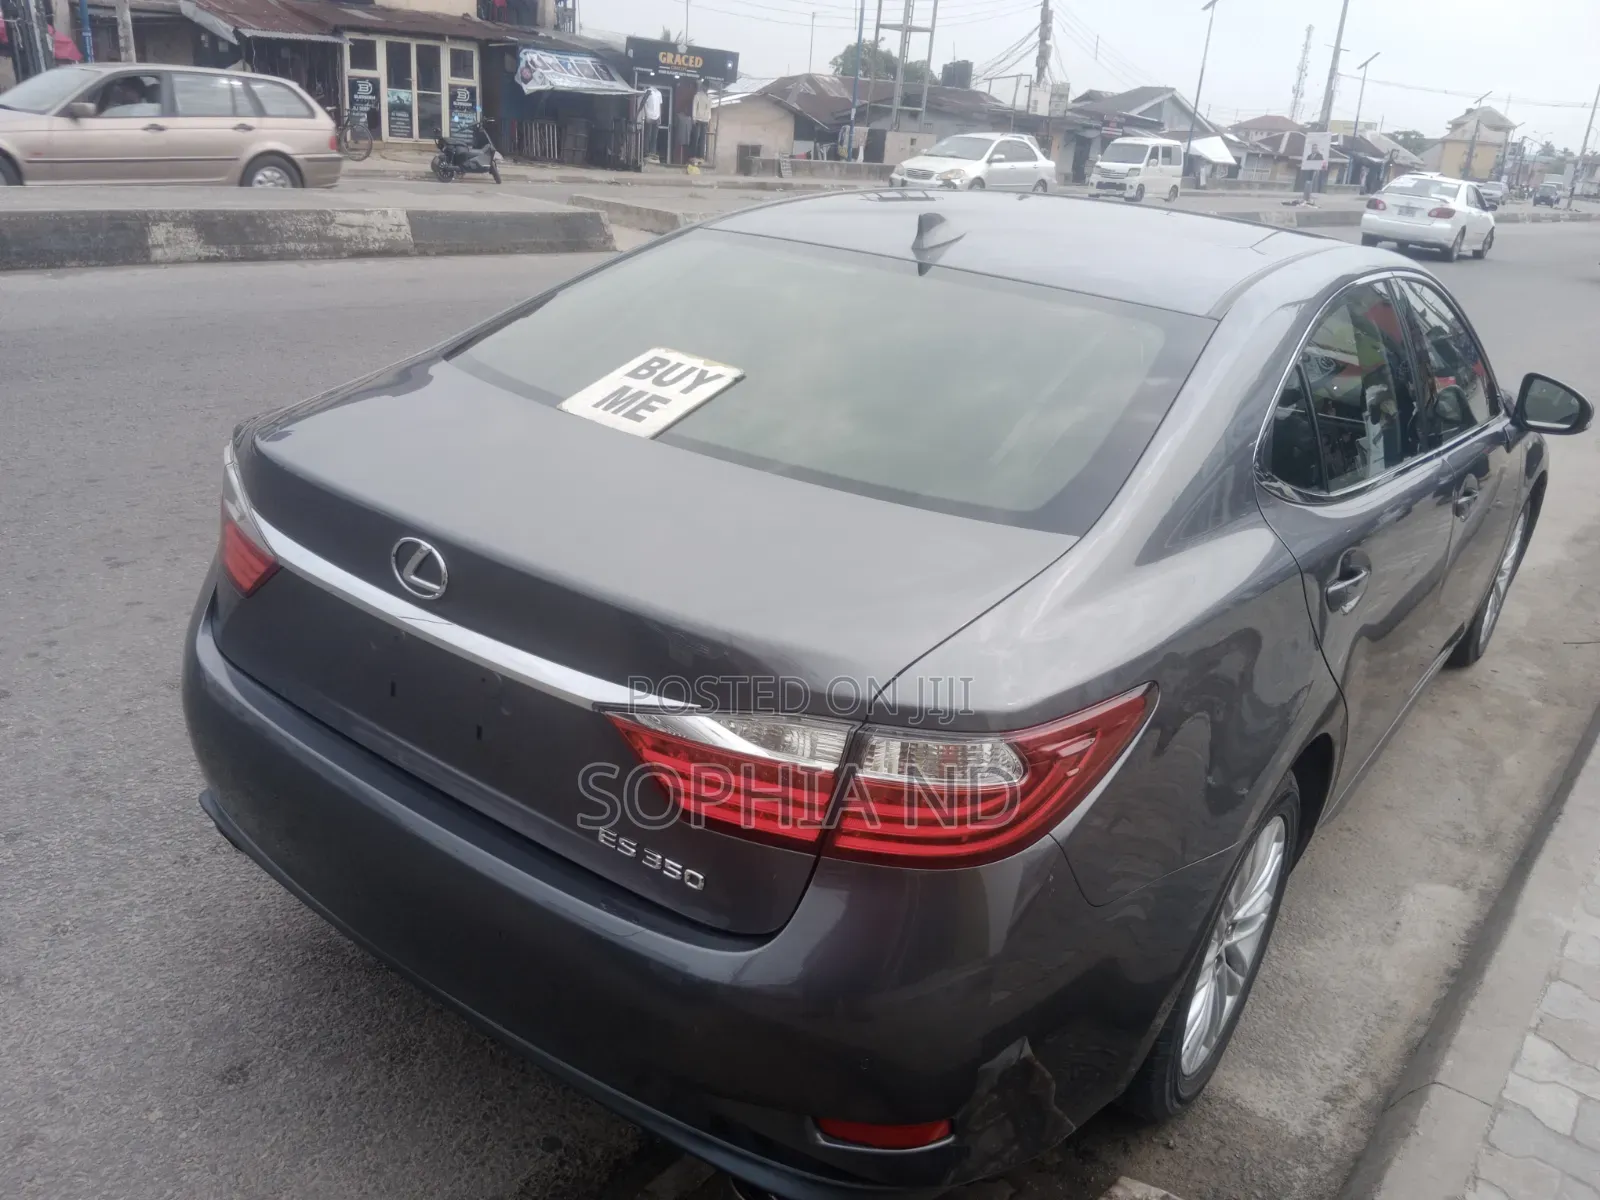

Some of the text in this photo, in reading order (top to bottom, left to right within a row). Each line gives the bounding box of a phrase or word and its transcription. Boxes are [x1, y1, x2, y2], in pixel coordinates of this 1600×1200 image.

[658, 51, 704, 68] GRACED
[624, 355, 726, 395] BUY
[591, 385, 673, 423] ME
[598, 827, 705, 890] ES 350
